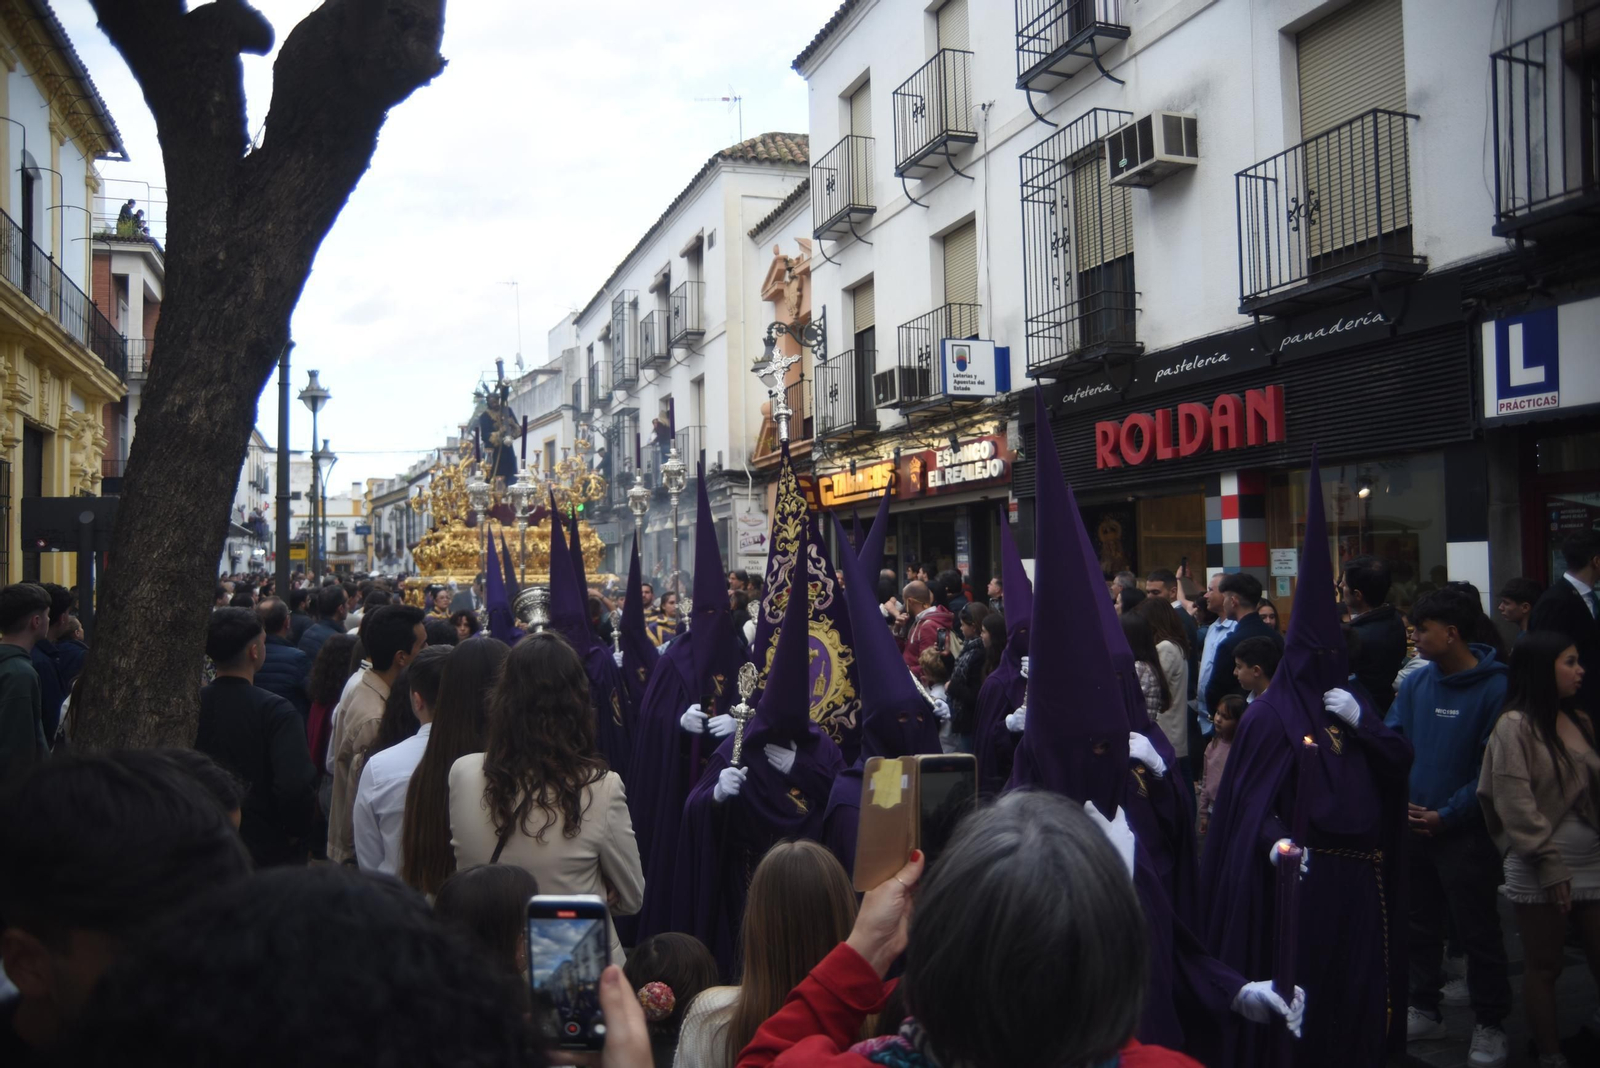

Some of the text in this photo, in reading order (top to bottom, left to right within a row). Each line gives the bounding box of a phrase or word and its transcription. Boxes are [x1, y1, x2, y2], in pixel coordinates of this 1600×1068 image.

[1278, 311, 1385, 352] panadería
[1508, 322, 1546, 388] L
[1499, 395, 1558, 413] PRÁCTICAS
[1094, 384, 1286, 470] ROLDAN
[927, 458, 1004, 488] EL REALEJO
